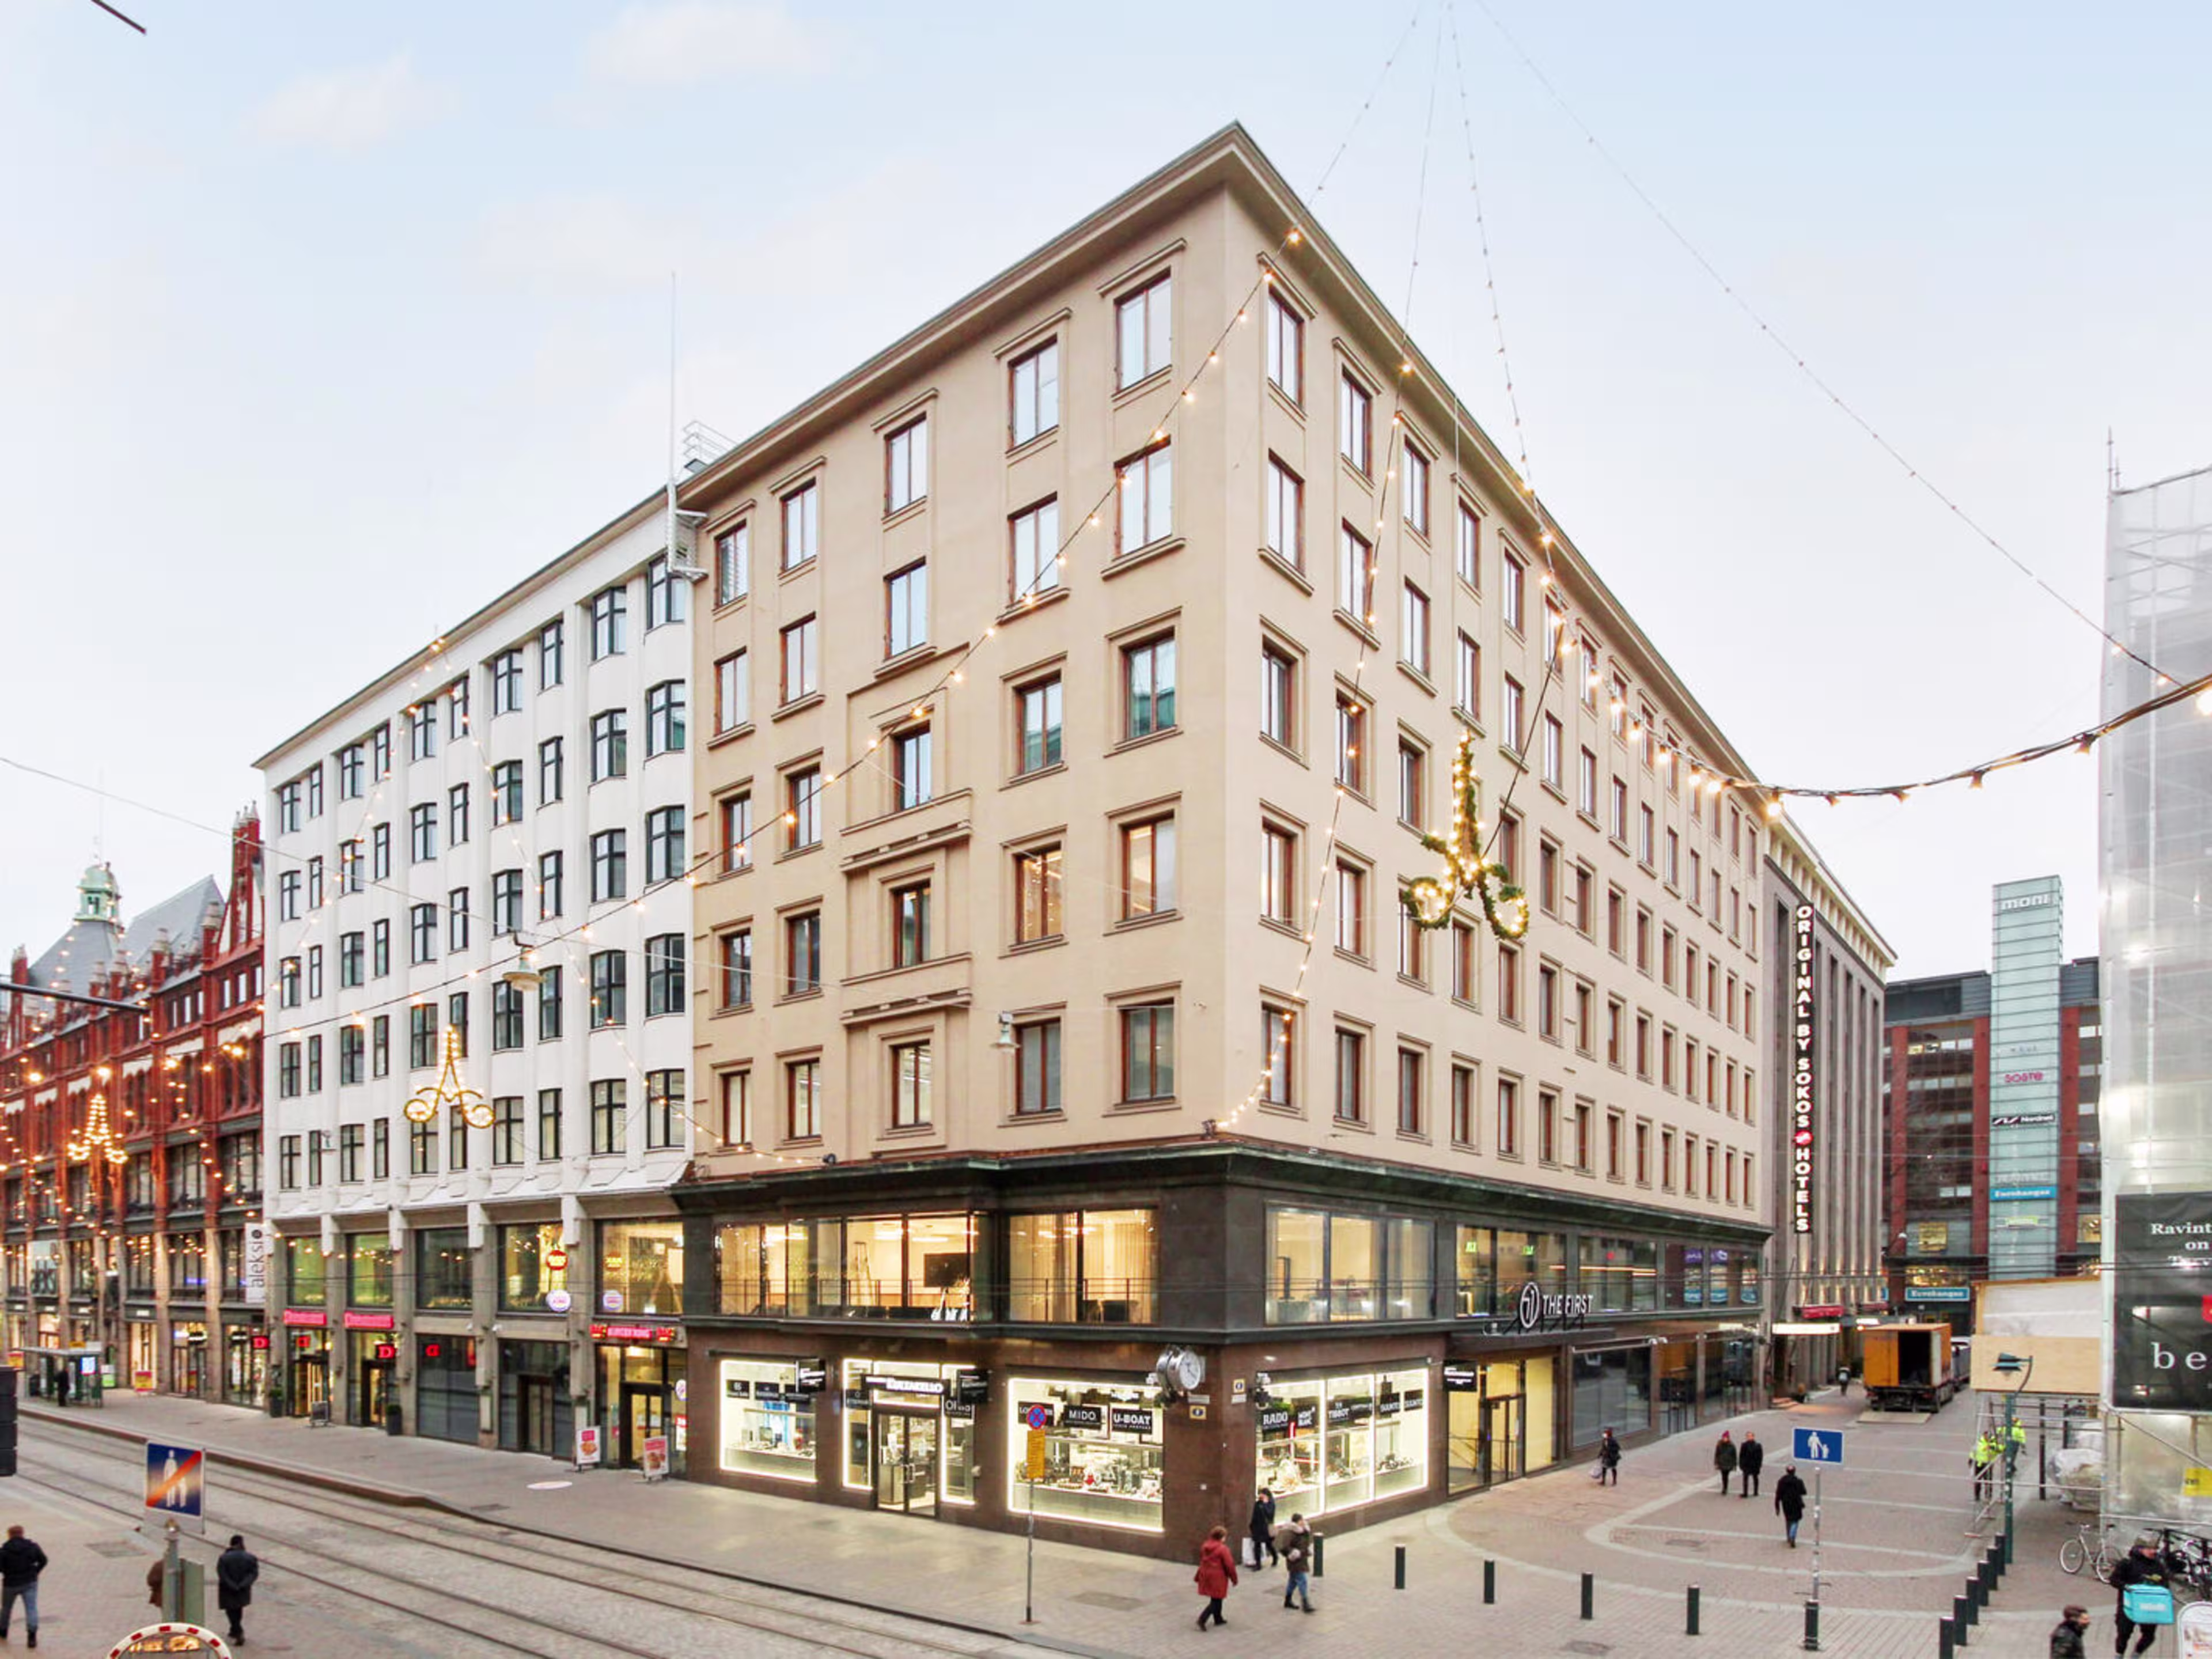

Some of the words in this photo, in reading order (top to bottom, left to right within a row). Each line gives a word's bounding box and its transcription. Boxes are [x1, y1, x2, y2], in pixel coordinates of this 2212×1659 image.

[1797, 906, 1813, 1018] ORIGINAL
[1797, 1024, 1811, 1051] BY
[1796, 1058, 1812, 1128] SOKOS
[1795, 1148, 1812, 1232] HOTELS
[2185, 1241, 2210, 1250] on
[1543, 1294, 1563, 1315] THE
[1565, 1294, 1594, 1315] FIRST
[1069, 1410, 1096, 1420] MIDO
[1113, 1414, 1151, 1425] U-BOAT
[1263, 1411, 1287, 1425] RADO
